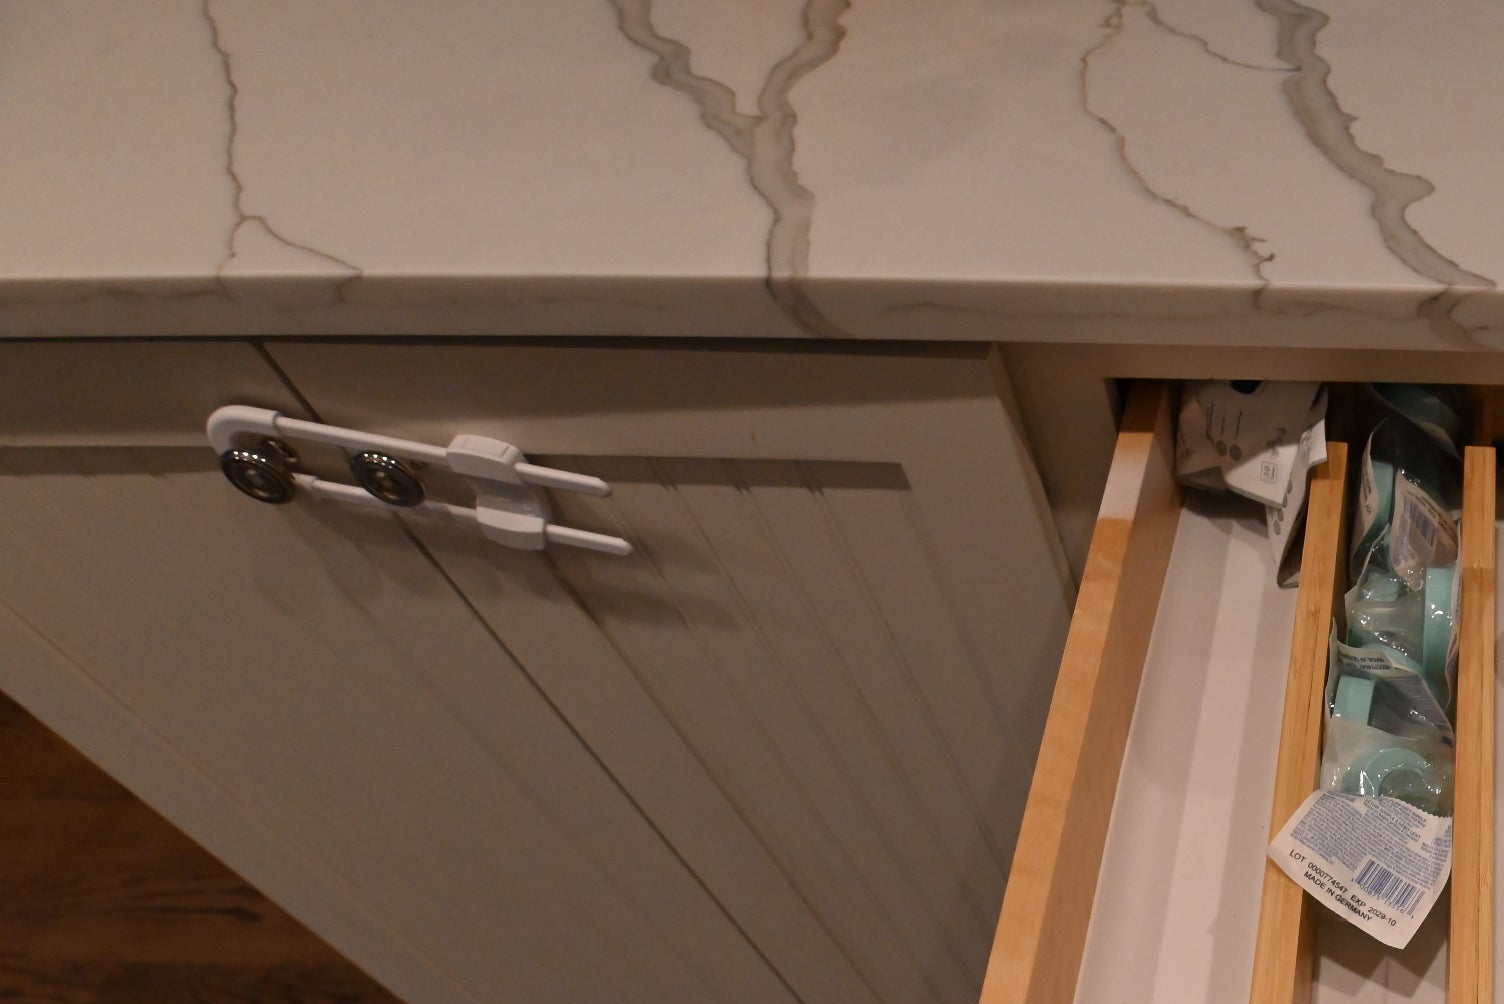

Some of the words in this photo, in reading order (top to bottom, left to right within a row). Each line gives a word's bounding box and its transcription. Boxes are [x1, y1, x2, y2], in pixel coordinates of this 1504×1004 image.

[1289, 849, 1306, 865] LOT
[1350, 894, 1367, 908] EXP
[1368, 905, 1397, 927] 2029-10
[1303, 871, 1327, 891] MADE
[1326, 887, 1335, 897] IN
[1335, 894, 1374, 923] GERMANY
